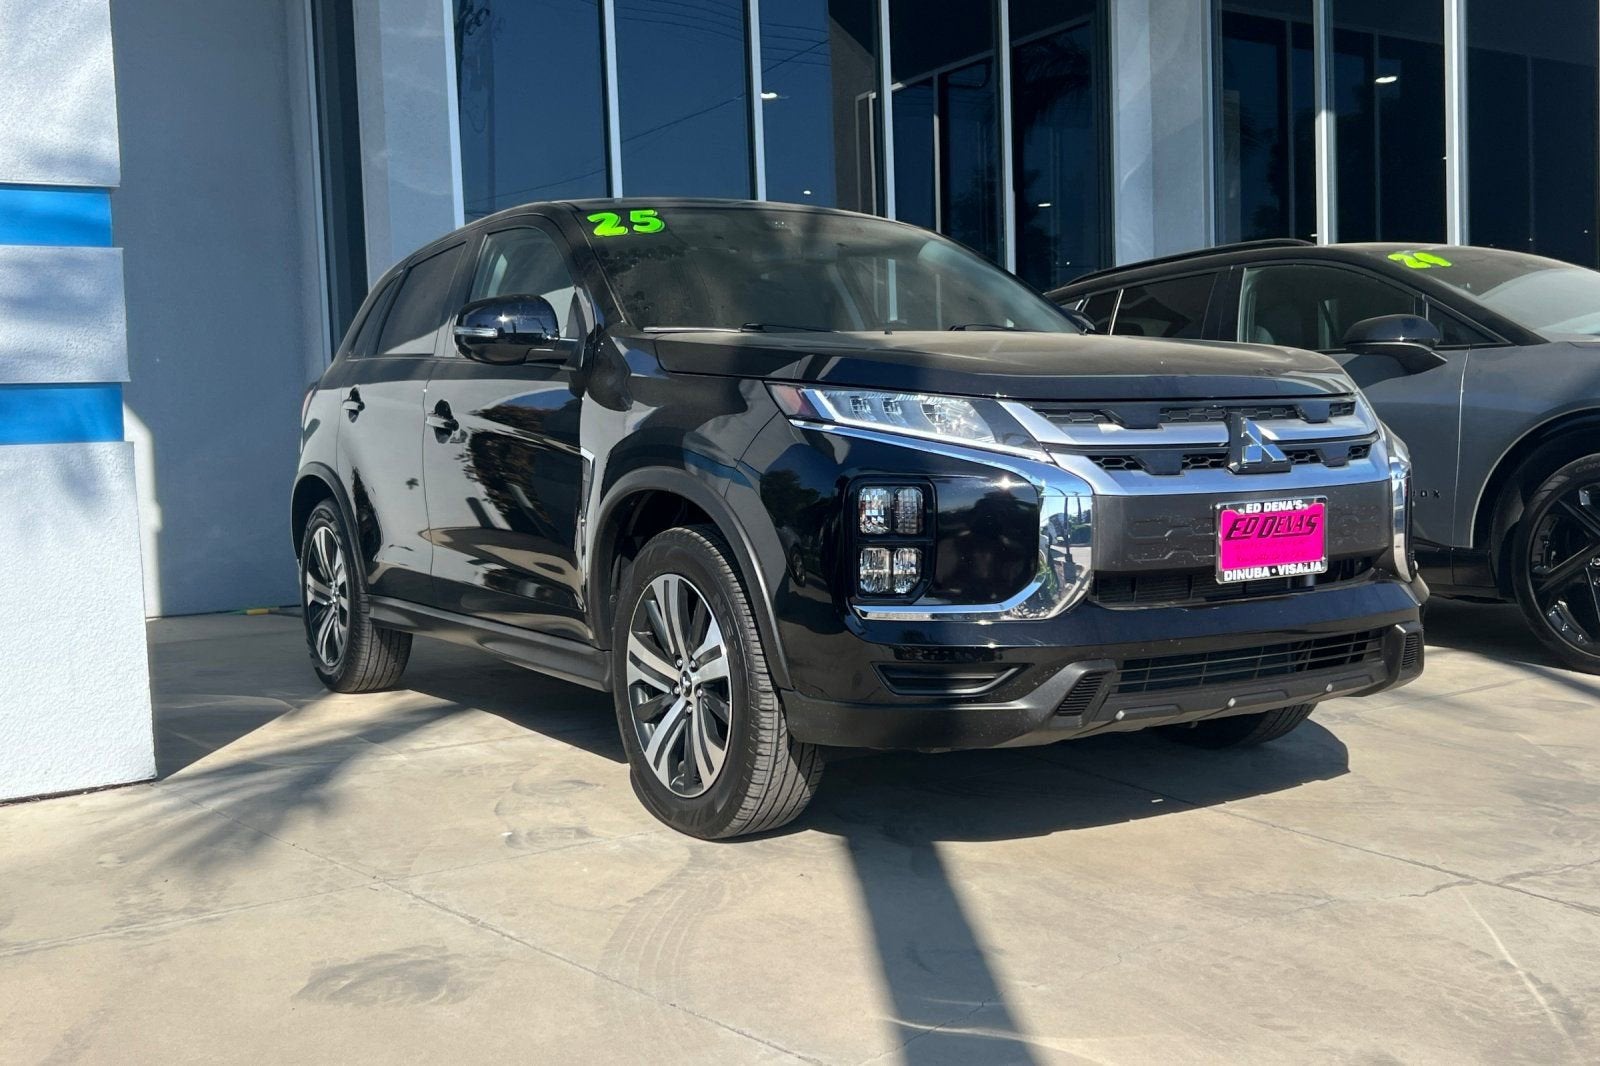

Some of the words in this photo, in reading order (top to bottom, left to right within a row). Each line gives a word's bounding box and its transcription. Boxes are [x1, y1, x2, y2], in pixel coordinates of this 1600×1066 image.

[587, 209, 665, 236] 25
[1245, 502, 1262, 514] ED
[1263, 499, 1303, 513] DENA'S
[1225, 516, 1260, 541] ED
[1223, 566, 1271, 582] DINUBA
[1277, 561, 1322, 576] VISALIA
